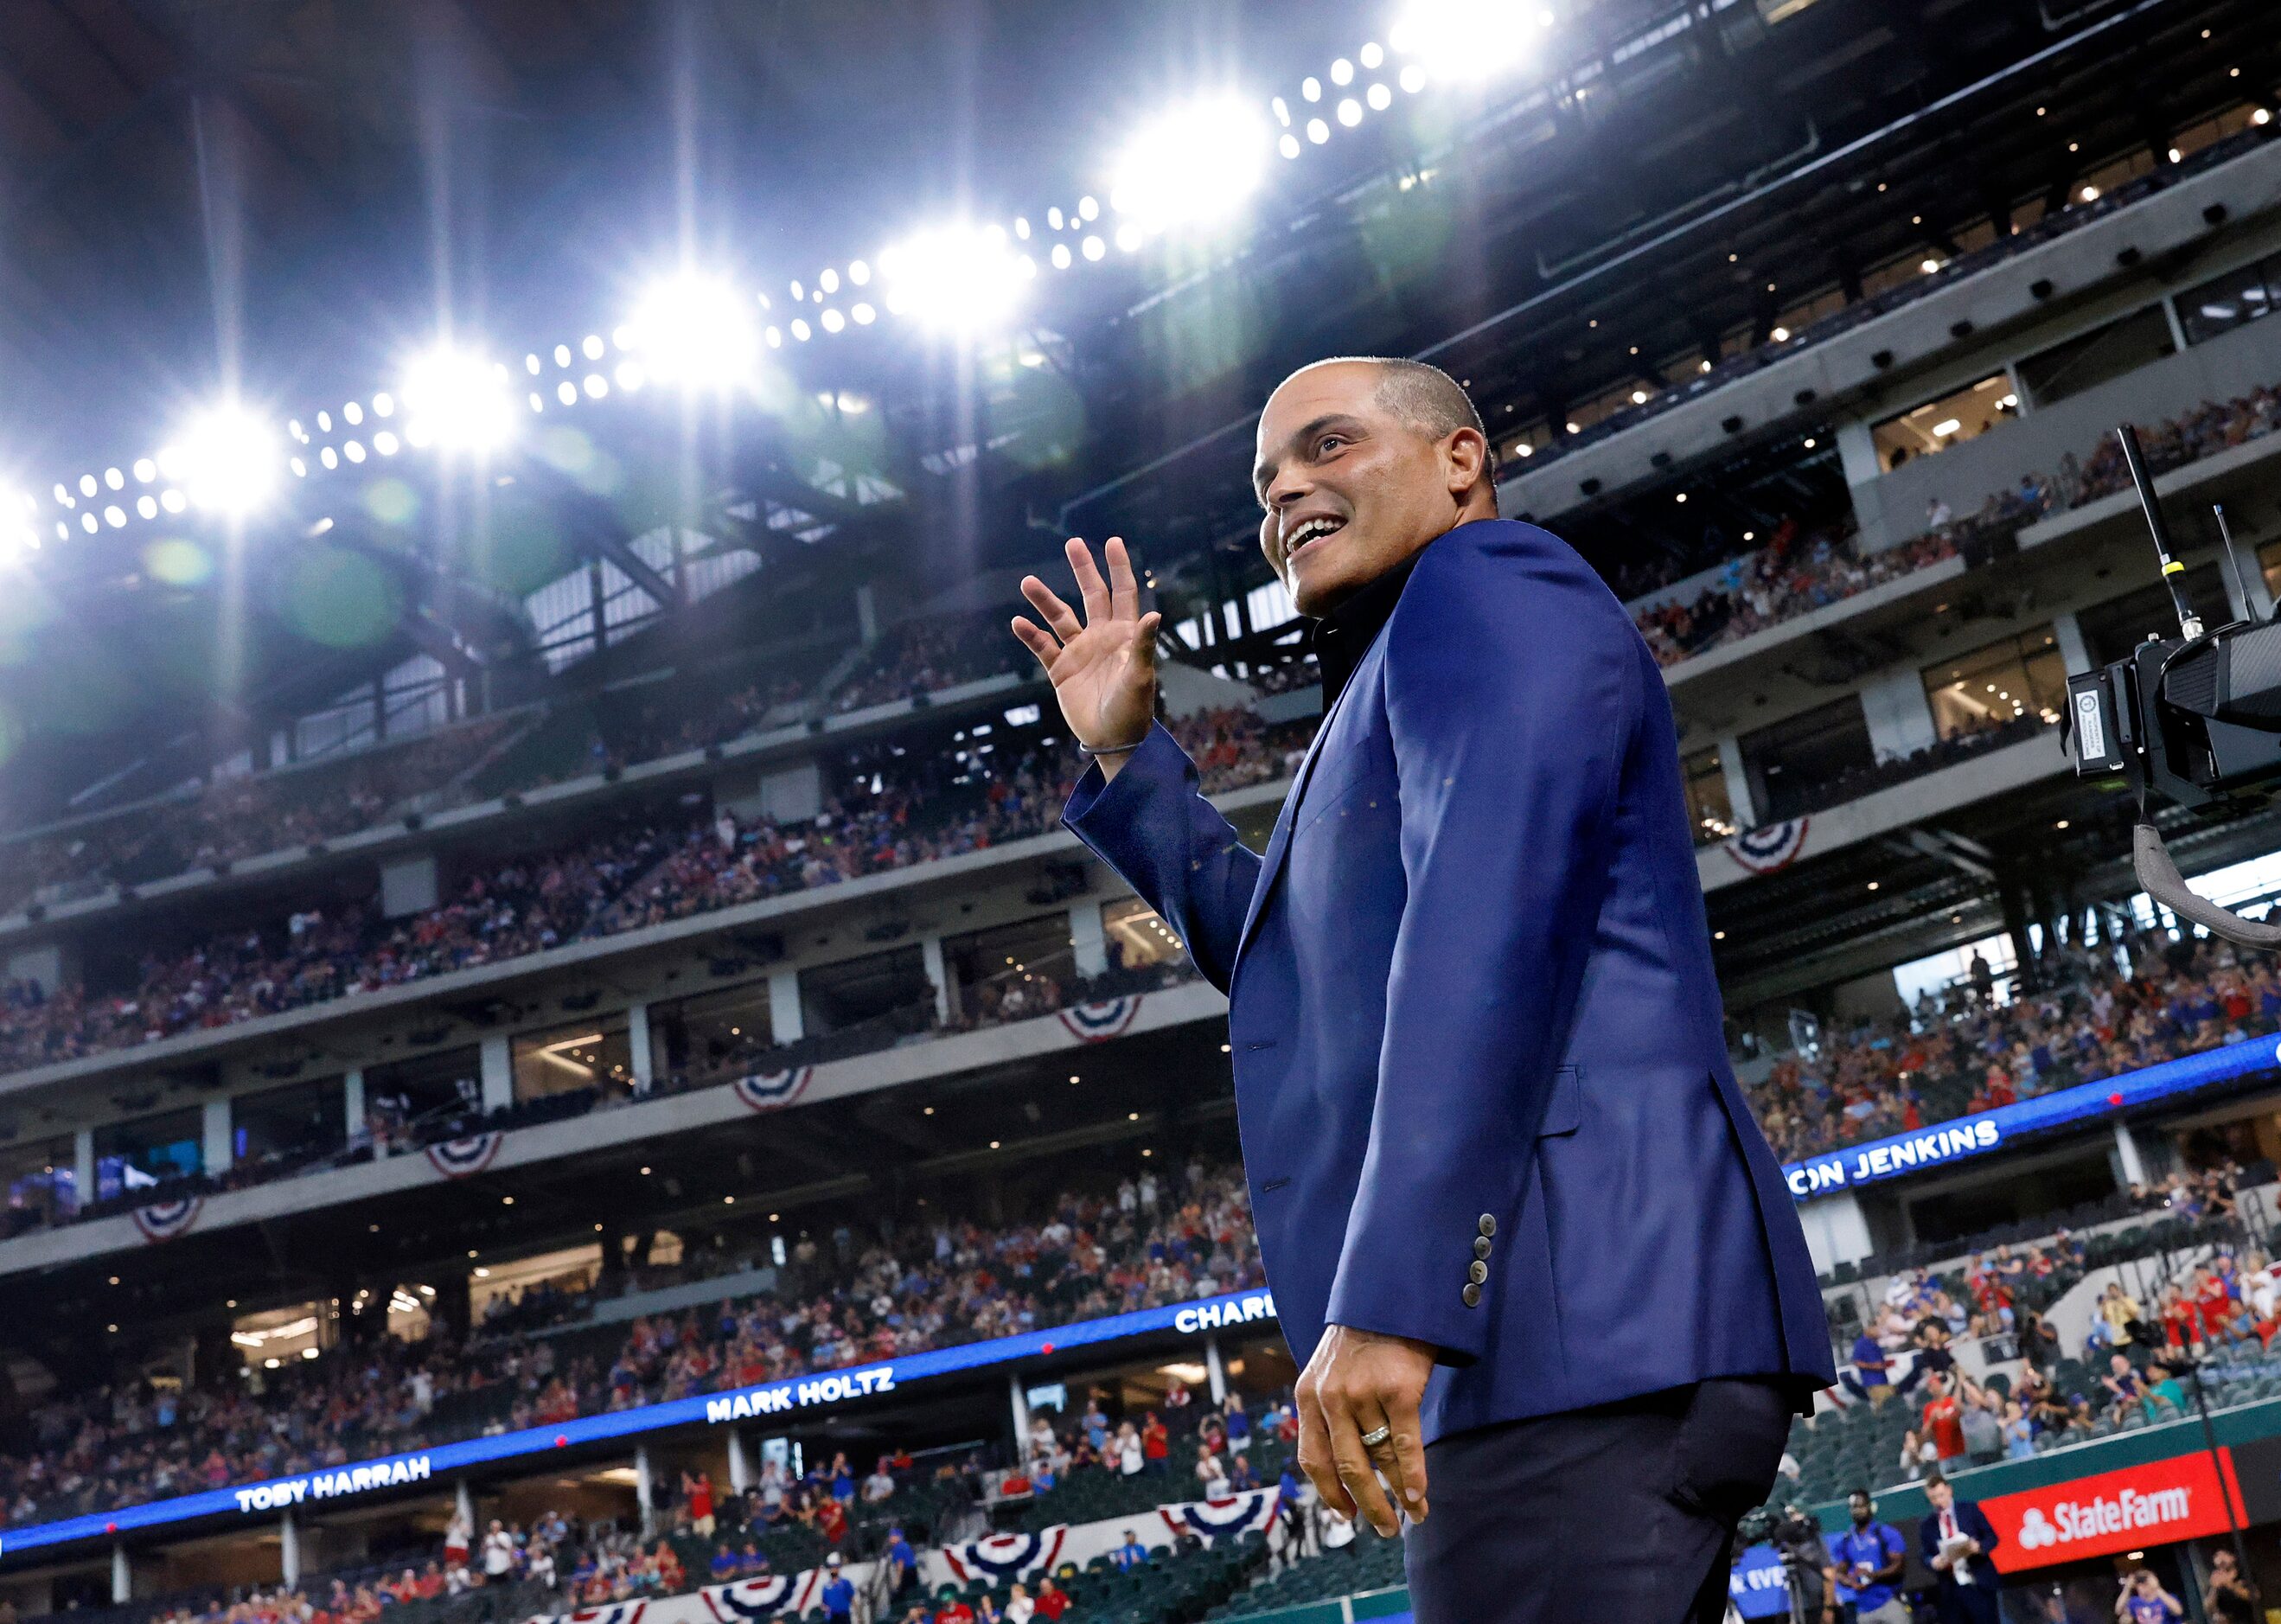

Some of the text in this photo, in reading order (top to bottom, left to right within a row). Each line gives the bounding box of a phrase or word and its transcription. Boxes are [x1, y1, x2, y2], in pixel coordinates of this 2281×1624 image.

[1785, 1120, 1999, 1195] ON JENKINS
[706, 1366, 896, 1423] MARK HOLTZ
[235, 1455, 431, 1512] TOBY HARRAH
